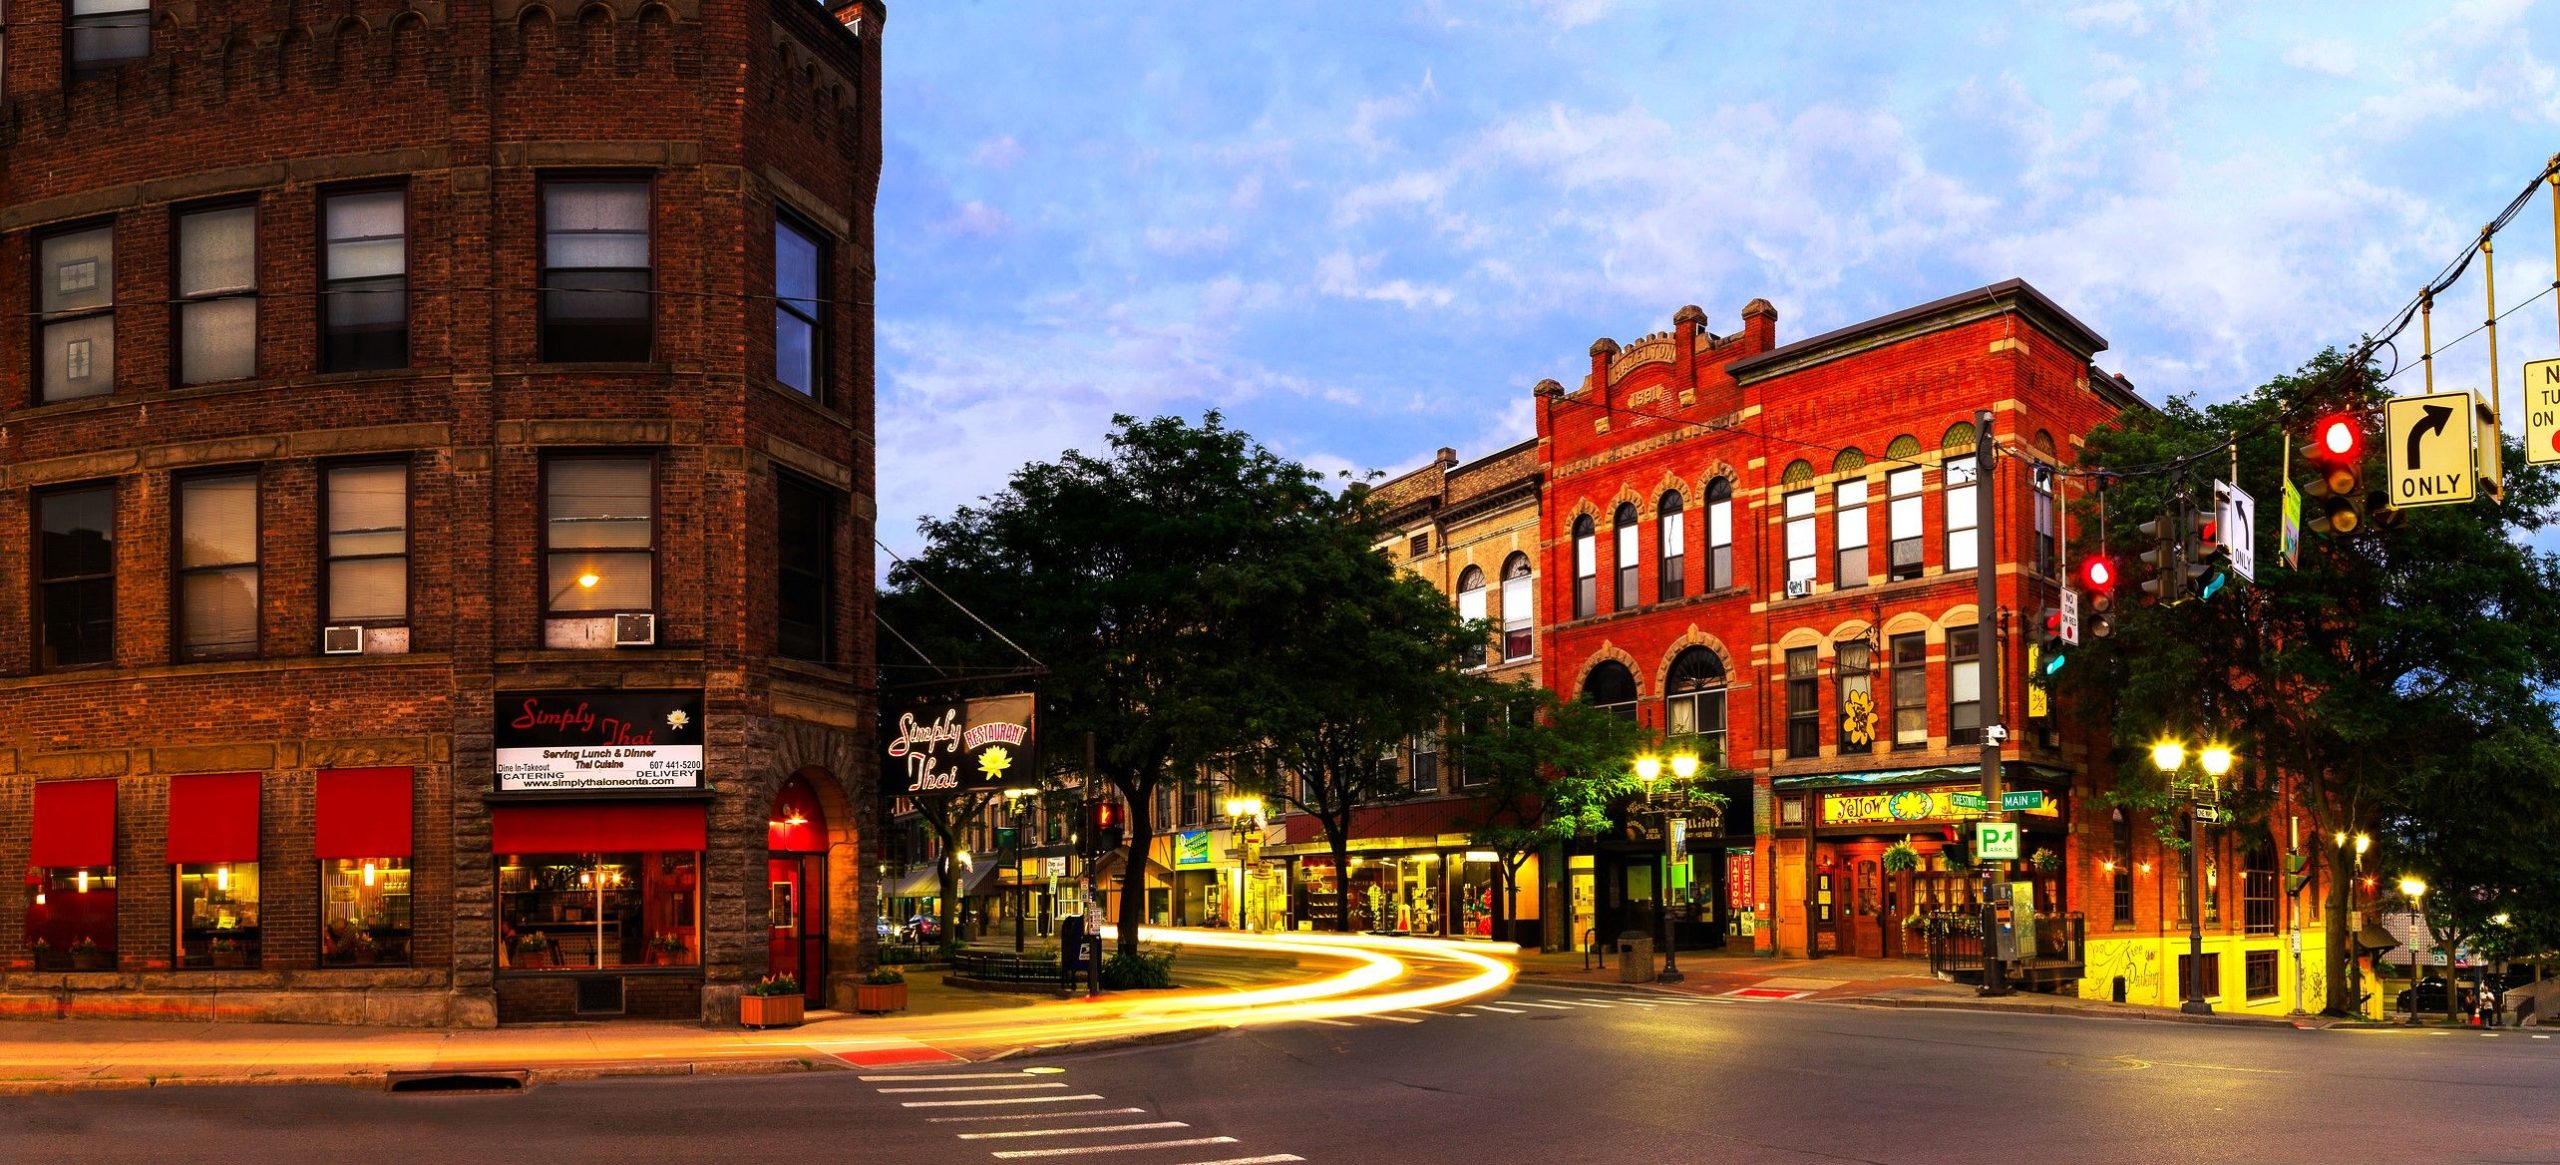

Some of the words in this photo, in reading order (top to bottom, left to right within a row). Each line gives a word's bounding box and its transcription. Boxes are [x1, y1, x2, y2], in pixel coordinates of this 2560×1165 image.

[2533, 411, 2553, 427] ON
[2402, 474, 2460, 498] ONLY
[2235, 548, 2251, 572] ONLY
[2065, 592, 2073, 605] NO
[2064, 604, 2075, 616] TURN
[2062, 614, 2068, 623] ON
[2069, 616, 2077, 627] RED
[511, 698, 595, 732] Simply
[602, 718, 655, 745] Thai
[888, 708, 962, 757] Simply
[964, 722, 1027, 750] RESTAURANT
[543, 750, 579, 760] Serving
[582, 749, 611, 758] Lunch
[614, 749, 621, 758] &
[623, 748, 656, 758] Dinner
[498, 764, 513, 772] Dine
[515, 763, 550, 772] In-Takeout
[575, 760, 592, 769] Thai
[594, 760, 624, 769] Cuisine
[649, 761, 663, 769] 607
[665, 760, 701, 769] 441-5200
[908, 752, 958, 791] Thai
[503, 772, 564, 780] CATERING
[2005, 796, 2028, 806] MAIN
[1743, 857, 1751, 904] PIERCING
